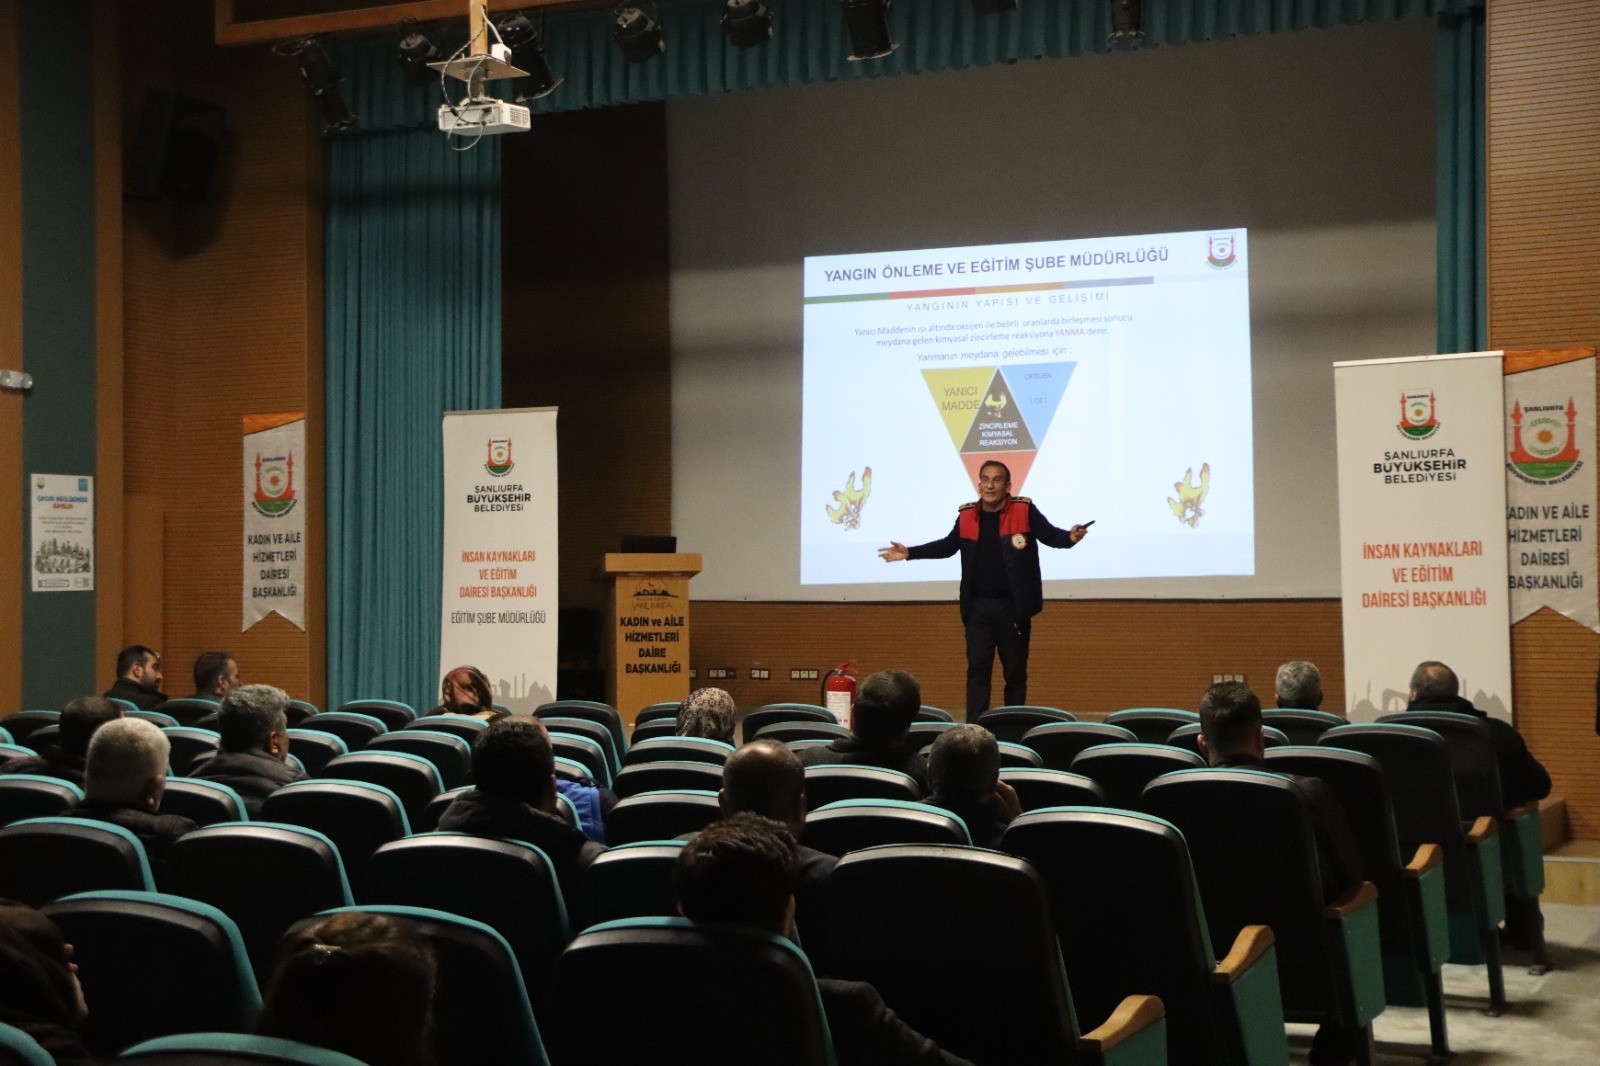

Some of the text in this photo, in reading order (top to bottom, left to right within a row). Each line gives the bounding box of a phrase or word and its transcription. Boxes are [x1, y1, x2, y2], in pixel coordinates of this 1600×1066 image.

[825, 246, 1169, 282] YANGIN ÖNLEME VE EĞİTİM ŞUBE MÜDÜRLÜĞÜ
[906, 291, 1109, 312] YANGININ YAPISI VE GELİŞİMİ
[854, 328, 877, 336] Yanıcı
[878, 325, 917, 335] Maddenin
[928, 323, 955, 332] altında
[956, 322, 984, 333] oksijen
[996, 319, 1019, 328] belirli
[1022, 317, 1060, 327] oranlarda
[1061, 315, 1102, 325] birleşmesi
[1103, 314, 1133, 322] sonucu
[876, 338, 911, 347] meydana
[912, 337, 934, 347] gelen
[935, 335, 969, 345] kimyasal
[970, 332, 1010, 342] zincirleme
[1011, 329, 1054, 340] reaksiyona
[1055, 327, 1085, 337] YANMA
[917, 351, 958, 362] Yanmanın
[961, 350, 999, 361] meydana
[1002, 347, 1049, 359] gelebilmesi
[1052, 347, 1067, 358] için
[943, 386, 978, 397] YANICI
[941, 400, 981, 411] MADDE
[978, 421, 1018, 430] ZİNCİRLEME
[981, 430, 1014, 438] KİMYASAL
[979, 438, 1018, 446] REAKSİYON
[1384, 448, 1455, 461] ŞANLIURFA
[1373, 458, 1467, 473] BÜYÜKŞEHİR
[1385, 472, 1456, 484] BELEDİYESİ
[475, 484, 523, 494] ŞANLIURFA
[467, 493, 531, 503] BÜYÜKŞEHİR
[474, 503, 524, 512] BELEDİYESİ
[1507, 502, 1590, 520] ADIN VE AİLE
[248, 530, 301, 545] KADIN VE AİLE
[1508, 525, 1582, 543] HİZMETLERİ
[253, 547, 297, 563] HİZMETLERİ
[462, 550, 536, 562] İNSAN KAYNAKLARI
[1363, 540, 1482, 560] İNSAN KAYNAKLARI
[1521, 548, 1570, 566] DAİRESİ
[260, 566, 289, 580] DAİRESİ
[479, 566, 517, 580] VE EĞİTİM
[1392, 564, 1453, 583] VE EĞİTİM
[1508, 571, 1584, 591] BAŞKANLIĞI
[252, 583, 297, 600] BAŞKANLIĞI
[460, 584, 537, 600] DAİRESİ BAŞKANLIĞI
[1362, 587, 1487, 610] DAİRESİ BAŞKANLIĞI
[451, 610, 546, 626] EĞİTİM ŞUBE MÜDÜRLÜĞÜ
[620, 614, 685, 627] KADIN ve AİLE
[625, 629, 679, 642] HİZMETLERİ
[638, 645, 666, 658] DAİRE
[625, 661, 681, 675] BAŞKANLIĞI
